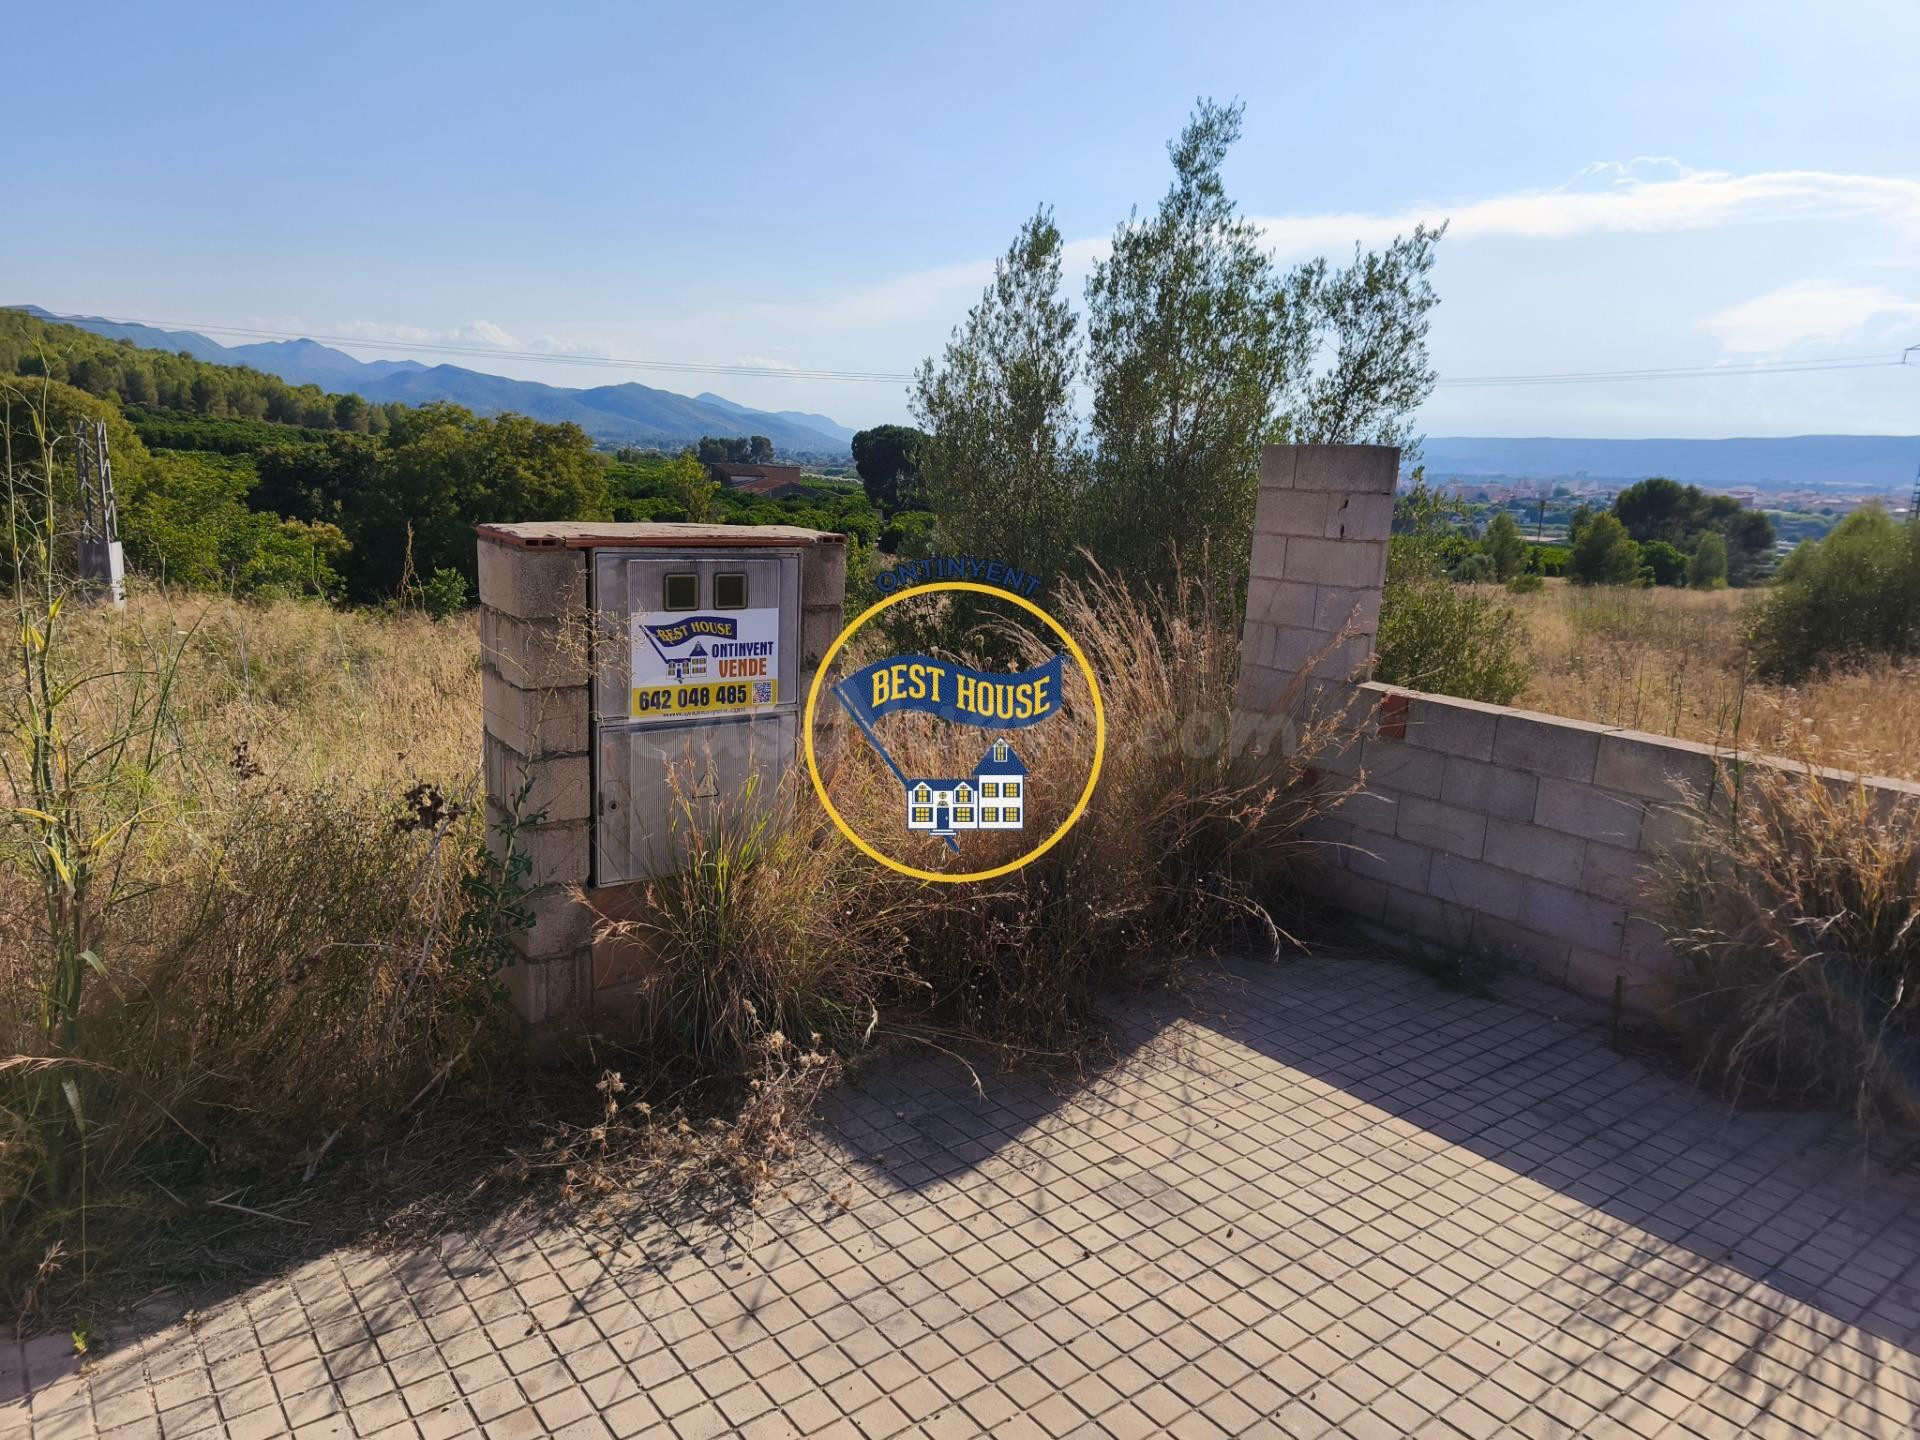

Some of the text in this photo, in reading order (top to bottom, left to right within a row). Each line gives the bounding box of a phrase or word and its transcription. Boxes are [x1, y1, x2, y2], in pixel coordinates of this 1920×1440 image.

[657, 621, 732, 642] BEST HOUSE
[712, 641, 774, 658] ONTINYENT
[718, 657, 767, 678] VENDE
[639, 684, 747, 711] 642 048 485
